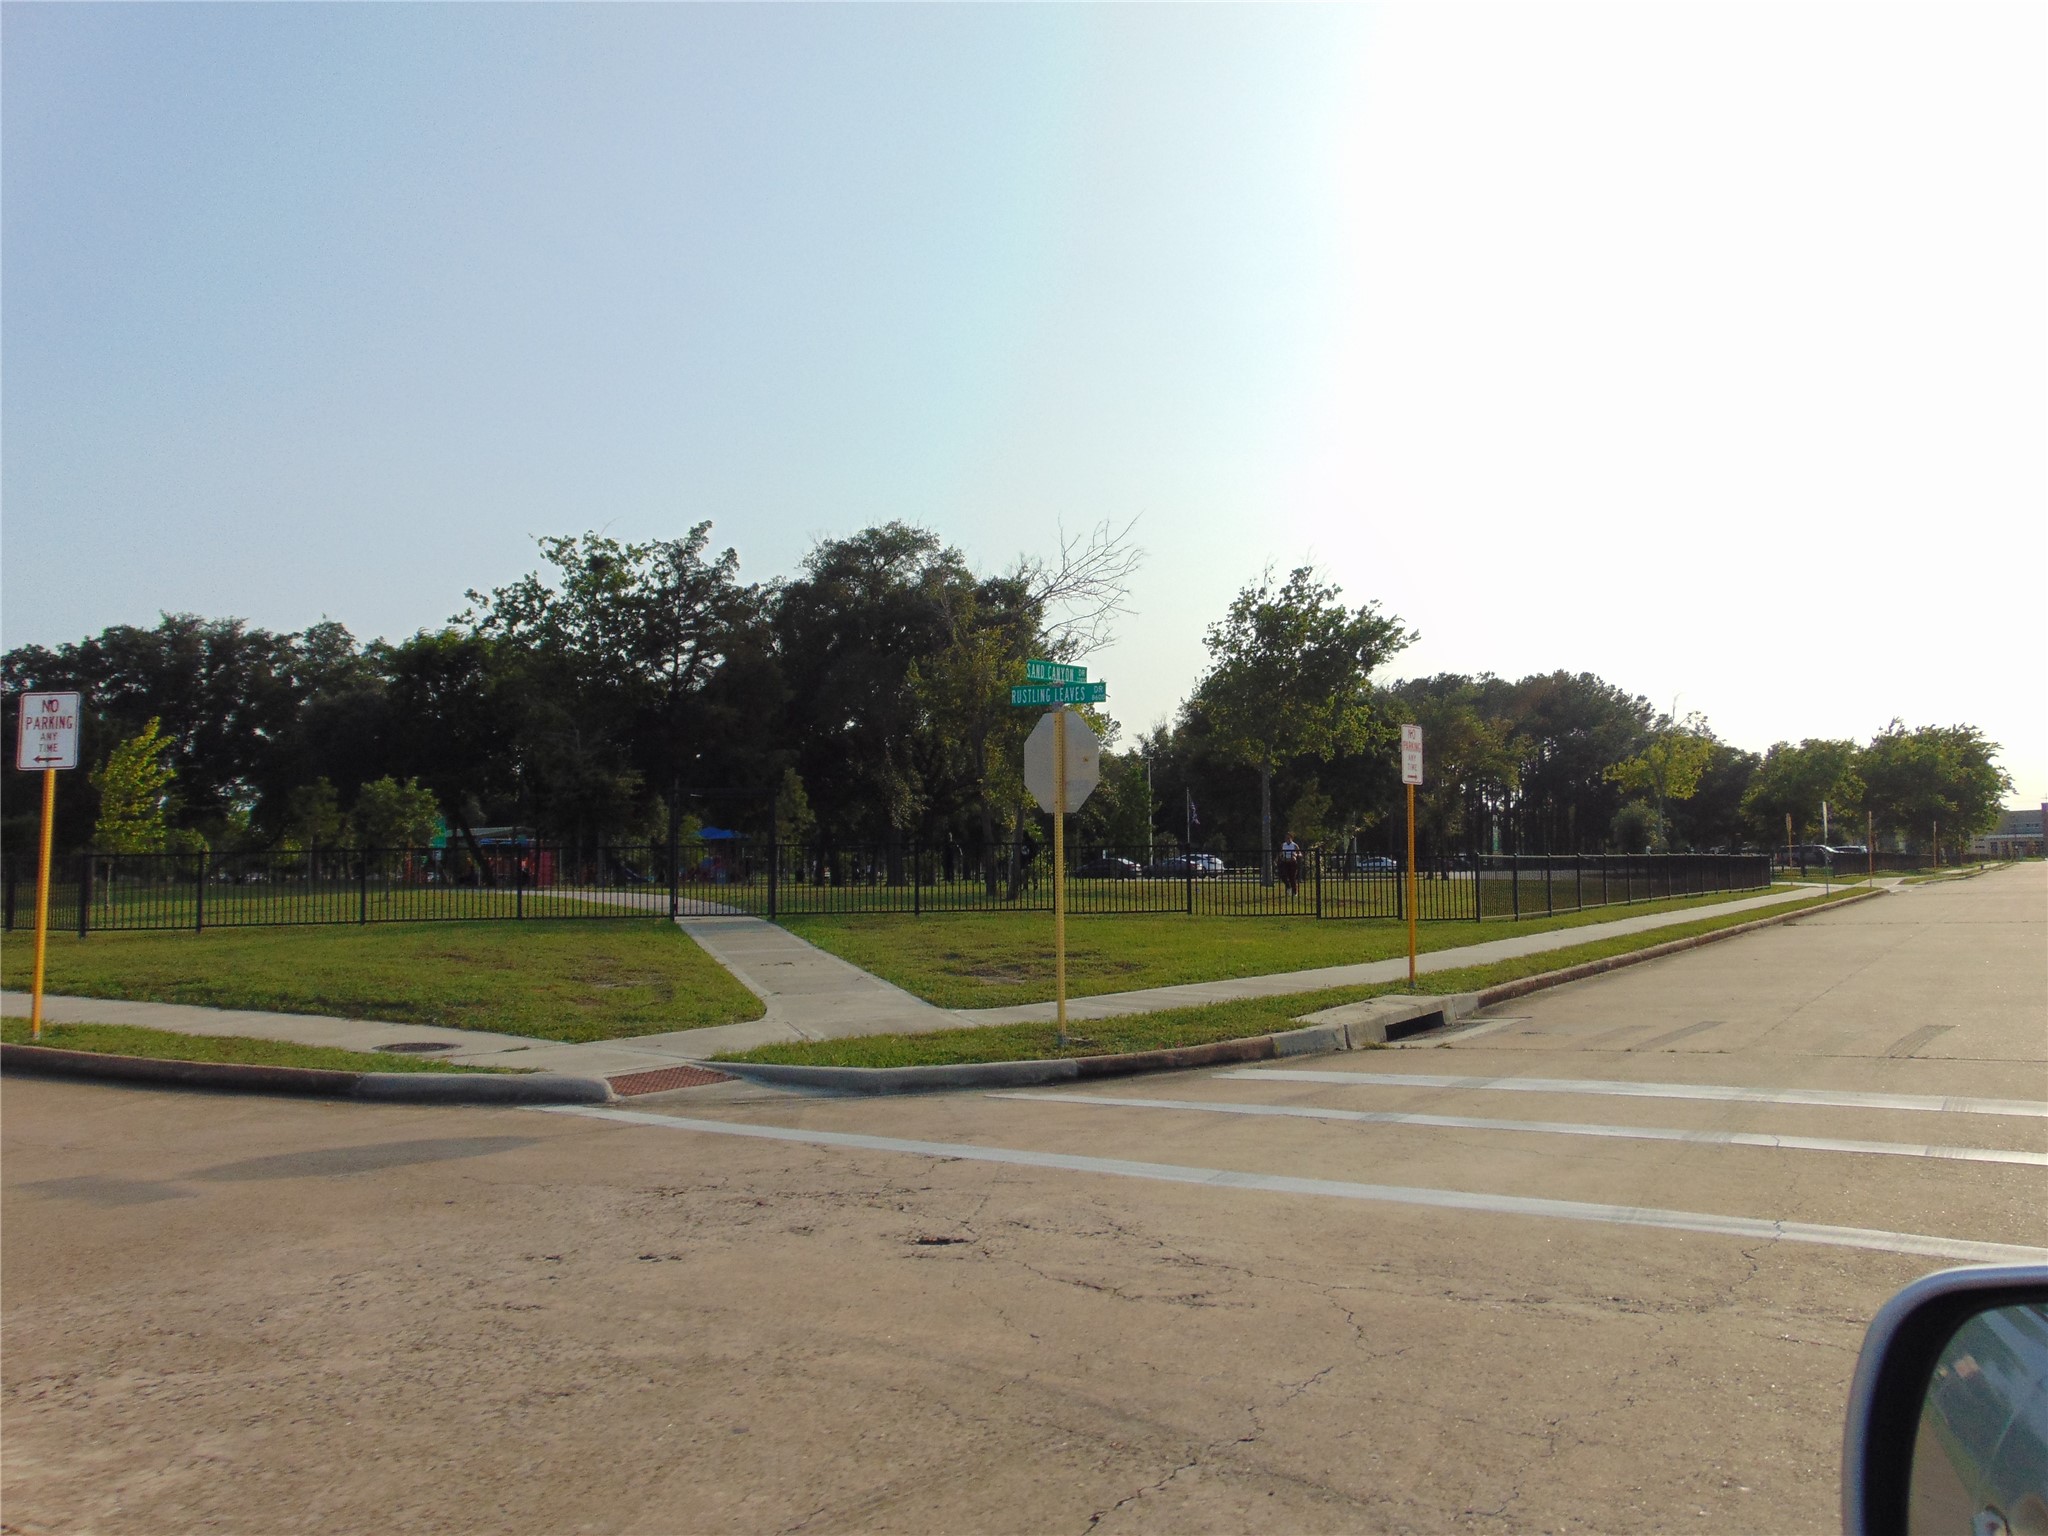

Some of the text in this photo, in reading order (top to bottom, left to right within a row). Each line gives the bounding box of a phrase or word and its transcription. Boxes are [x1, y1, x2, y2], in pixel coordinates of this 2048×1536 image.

[1026, 663, 1086, 682] SAND CANYON DR
[1011, 686, 1104, 704] RUSTLING LEAVES DR
[42, 699, 59, 713] NO
[25, 715, 73, 730] PARKING
[40, 732, 58, 741] ANY
[1407, 728, 1416, 740] NO
[38, 743, 58, 752] TIME
[1402, 740, 1421, 753] PARKING
